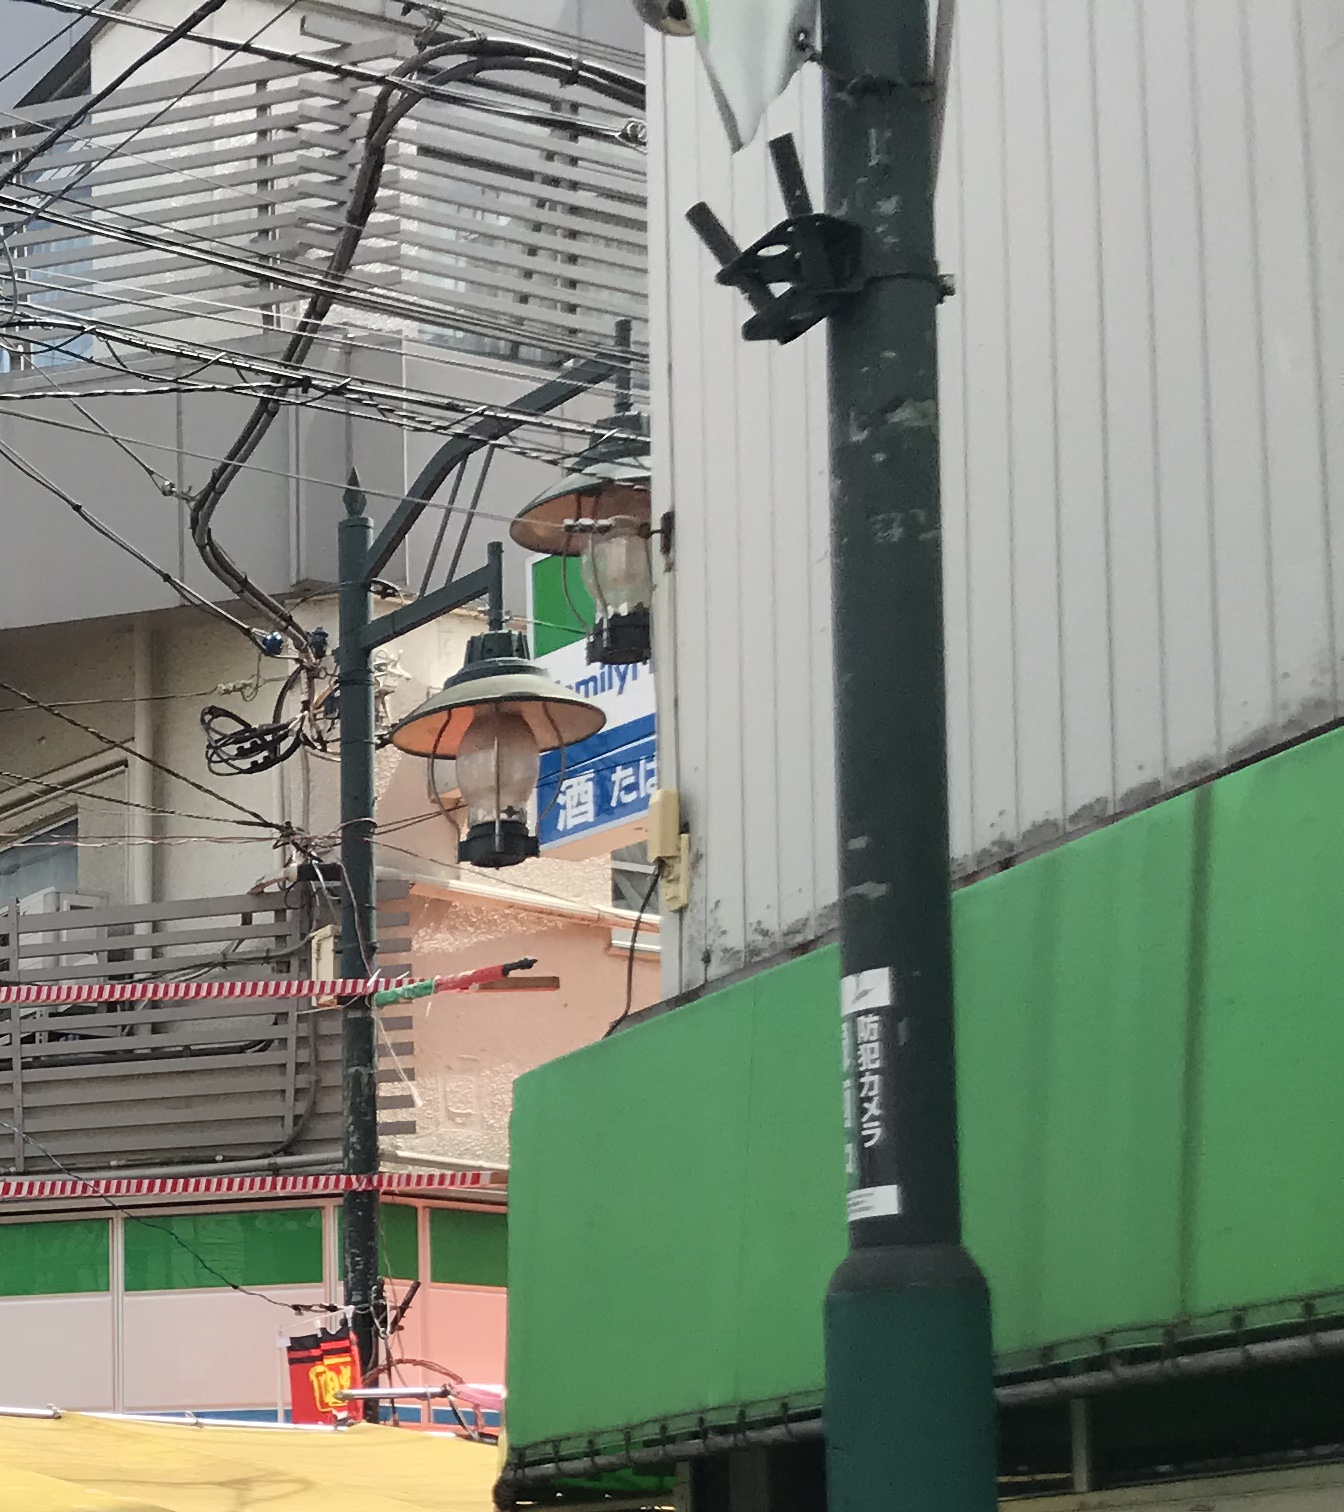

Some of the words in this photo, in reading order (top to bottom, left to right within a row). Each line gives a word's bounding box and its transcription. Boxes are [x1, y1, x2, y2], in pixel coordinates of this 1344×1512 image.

[556, 769, 595, 831] 酒
[857, 1012, 883, 1148] 防犯カメラ
